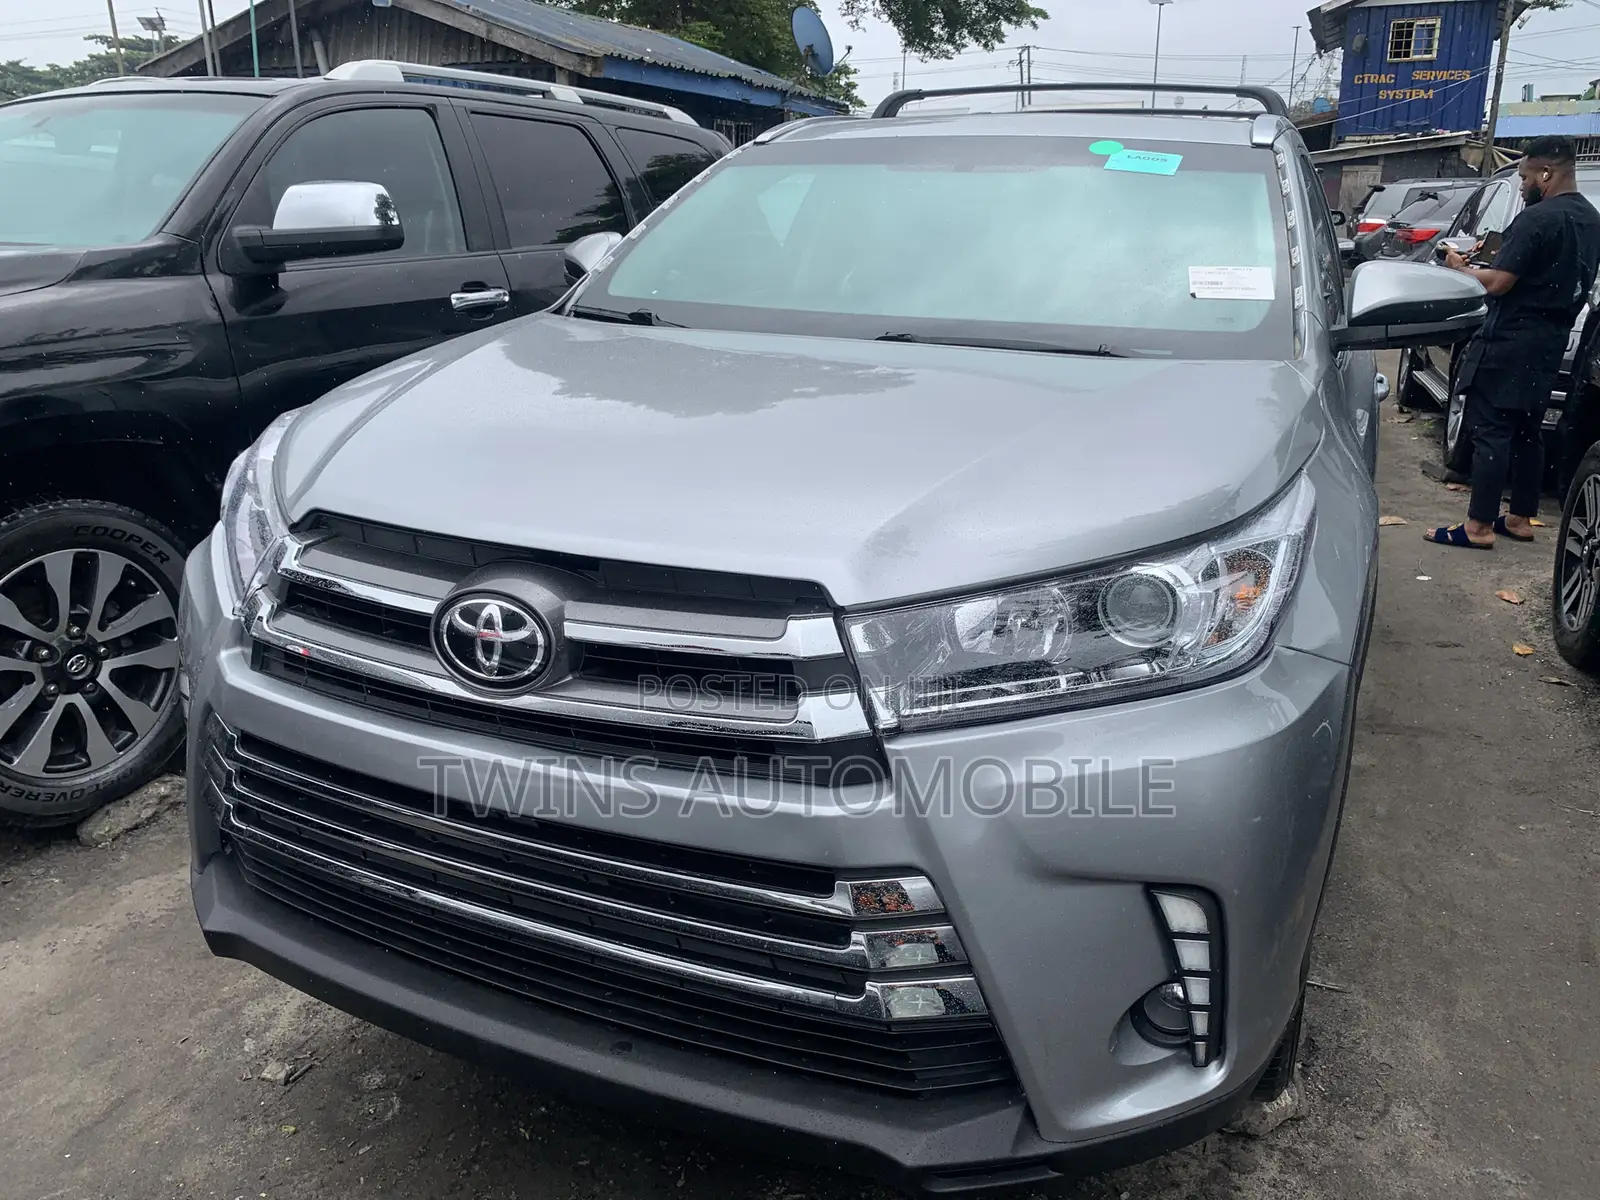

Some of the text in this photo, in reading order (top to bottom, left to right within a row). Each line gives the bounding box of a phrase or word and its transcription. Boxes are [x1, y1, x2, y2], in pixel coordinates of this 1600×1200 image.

[1354, 70, 1471, 84] CTRAC SERVICES
[1378, 89, 1434, 100] SYSTEM
[74, 525, 170, 565] COOPER
